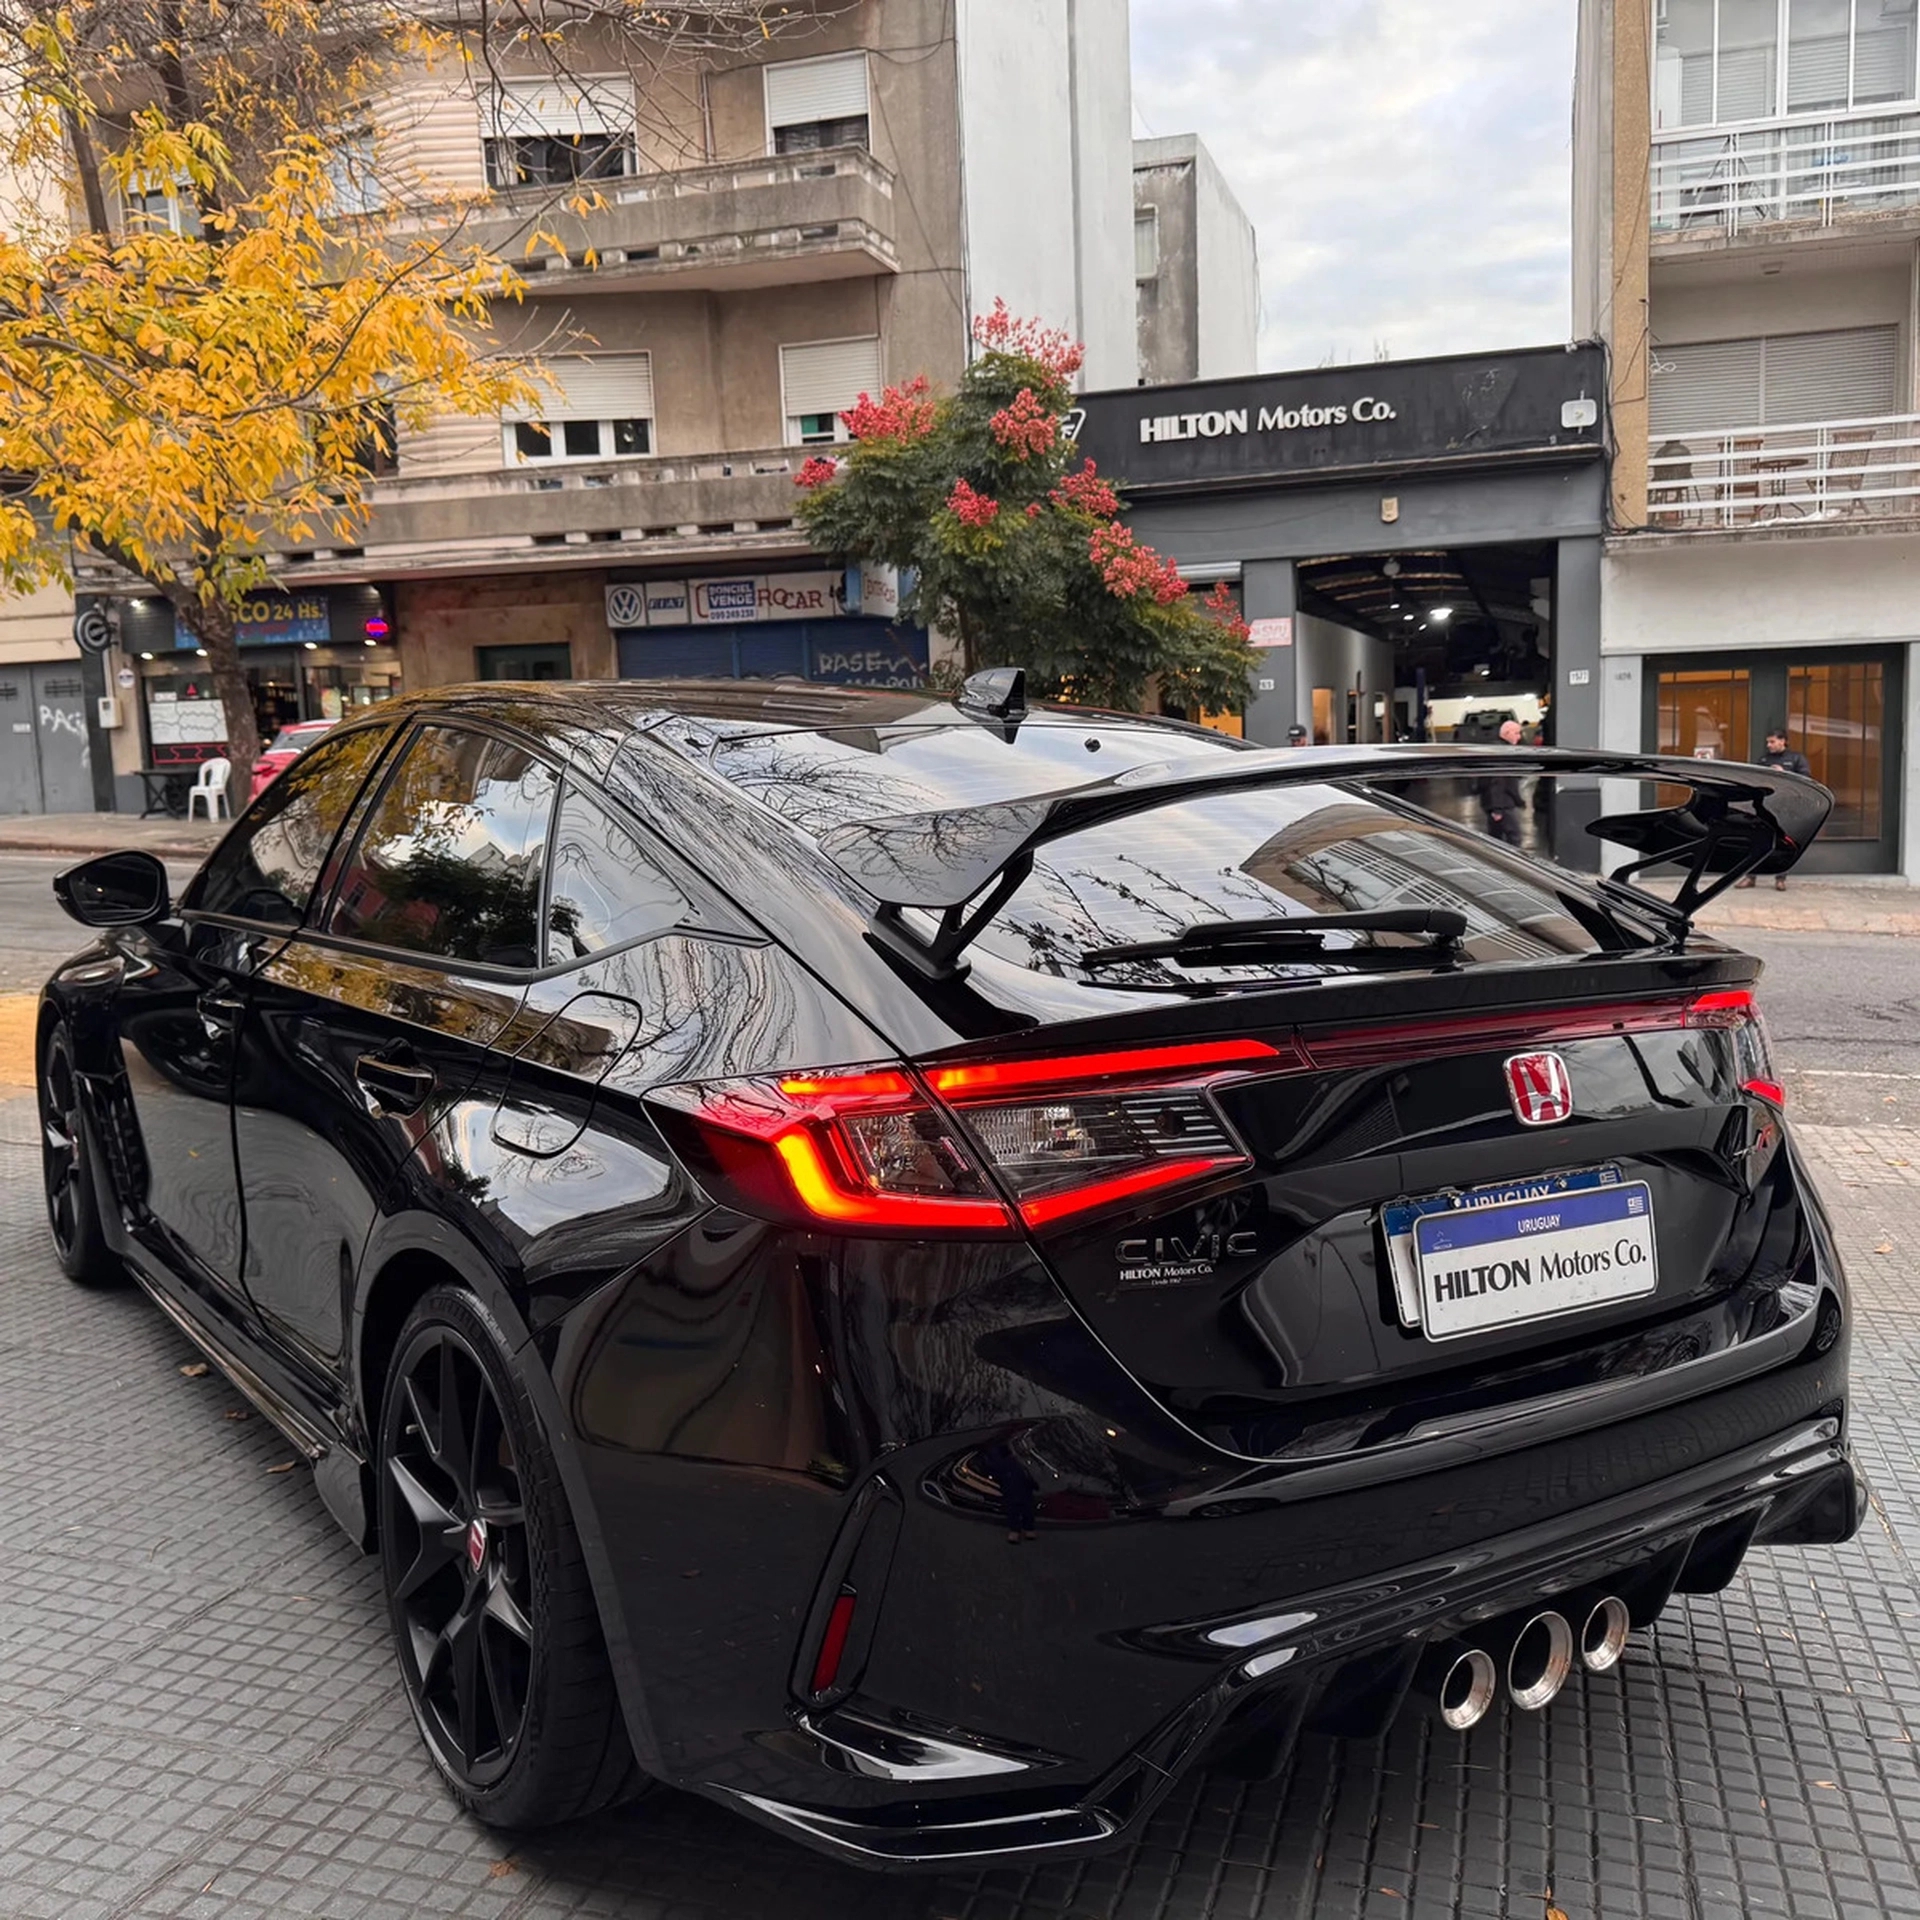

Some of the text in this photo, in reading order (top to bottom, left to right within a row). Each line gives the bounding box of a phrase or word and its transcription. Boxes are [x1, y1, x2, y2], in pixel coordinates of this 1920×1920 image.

[1140, 397, 1397, 443] HILTON Motors Co.
[710, 593, 753, 606] VENDE
[757, 588, 824, 610] ROCAR
[274, 604, 294, 621] 24
[1517, 1214, 1561, 1233] URUGUAY
[1115, 1231, 1257, 1264] CIVIC
[1119, 1263, 1214, 1280] HILTON Motors Co.
[1433, 1239, 1647, 1302] HILTON Motors Co.
